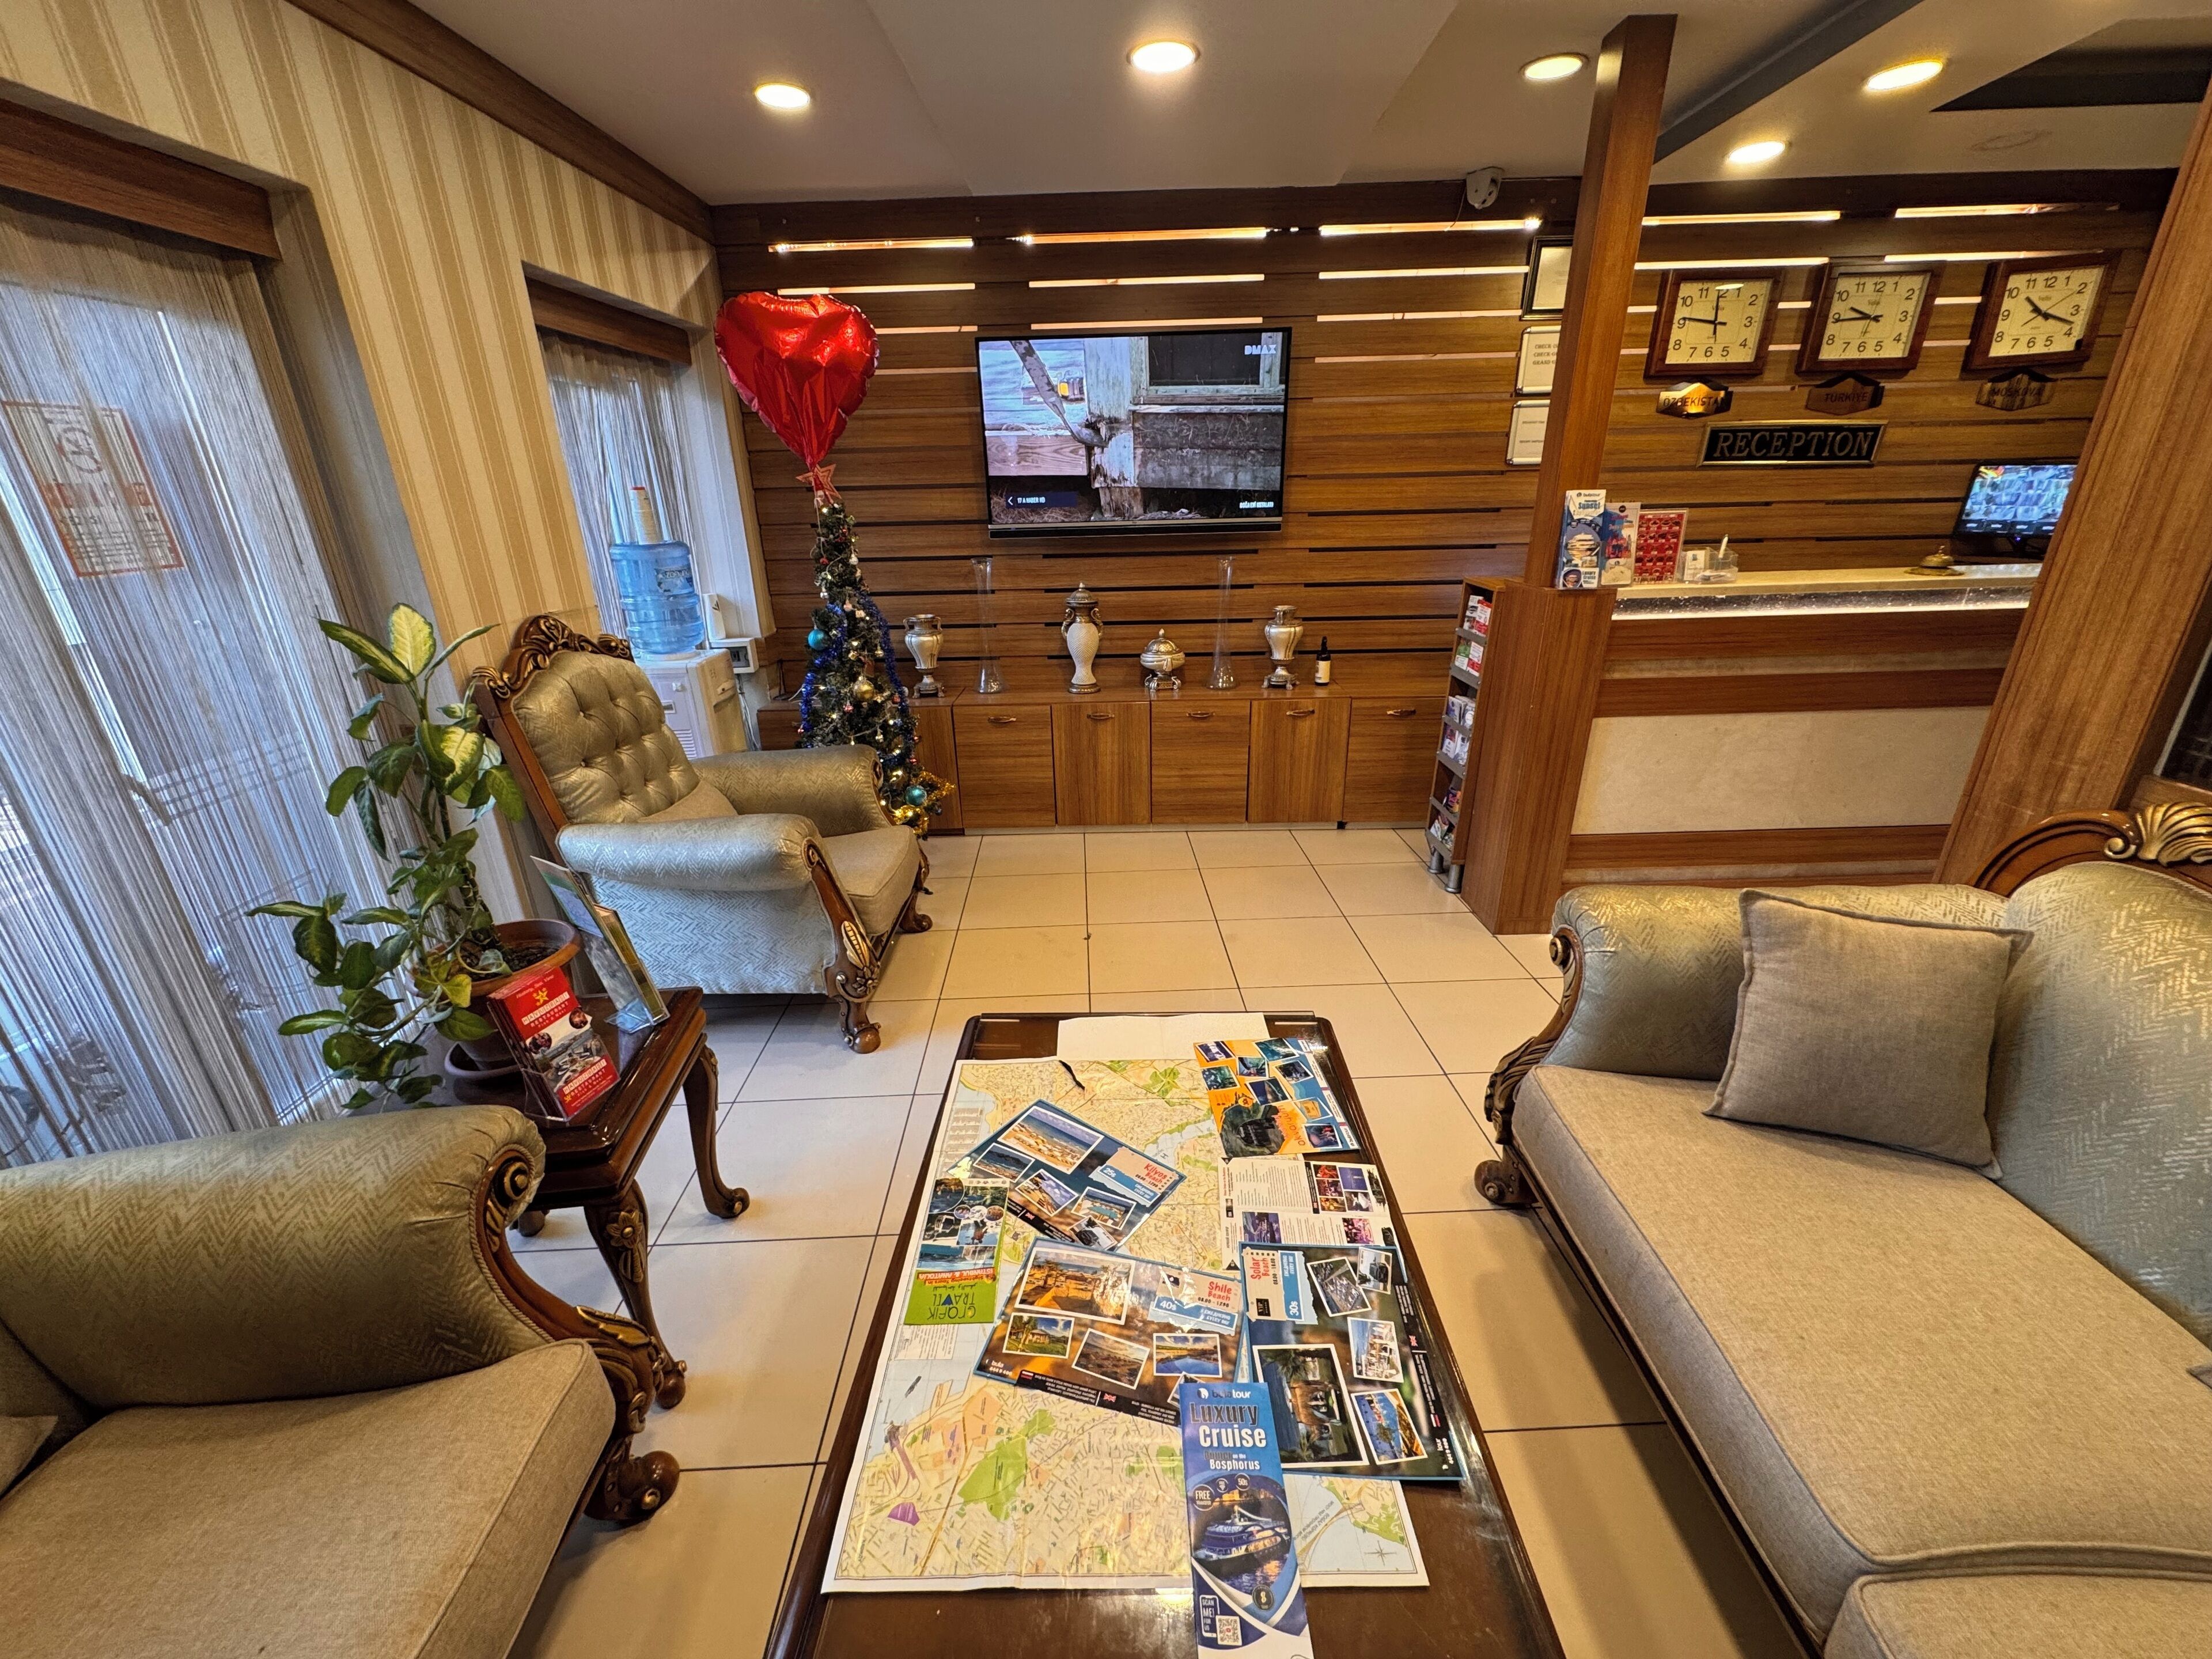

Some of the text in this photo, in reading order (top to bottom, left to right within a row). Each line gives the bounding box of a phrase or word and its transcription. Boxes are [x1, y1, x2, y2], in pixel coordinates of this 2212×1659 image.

[1873, 281, 1887, 293] 12
[1893, 281, 1899, 292] 1
[2026, 278, 2037, 289] 11
[2043, 276, 2058, 288] 12
[2065, 275, 2070, 287] 1
[1699, 287, 1709, 298] 11
[1855, 282, 1866, 293] 11
[2005, 287, 2020, 299] 10
[2076, 282, 2088, 294] 2
[1748, 294, 1758, 306] 2
[1836, 290, 1849, 302] 10
[1904, 289, 1915, 300] 2
[1680, 296, 1693, 307] 10
[1899, 310, 1908, 322] 3
[2001, 309, 2010, 321] 9
[2070, 304, 2080, 316] 3
[1677, 317, 1686, 329] 9
[1744, 316, 1753, 327] 3
[1832, 312, 1840, 324] 9
[1893, 332, 1902, 343] 4
[1994, 331, 2004, 343] 8
[2063, 327, 2073, 337] 4
[1673, 339, 1681, 351] 8
[1739, 338, 1748, 349] 4
[1826, 334, 1835, 346] 8
[1874, 340, 1884, 352] 5
[2011, 338, 2020, 350] 7
[2027, 337, 2036, 348] 6
[2044, 335, 2054, 347] 5
[1245, 344, 1277, 355] DMAX
[1689, 347, 1698, 358] 7
[1704, 346, 1713, 357] 6
[1721, 346, 1729, 357] 5
[1842, 342, 1850, 353] 7
[1857, 341, 1866, 352] 6
[1713, 431, 1874, 457] RECEPTION
[1145, 1172, 1162, 1184] Beach
[1250, 1257, 1261, 1280] Solar
[1260, 1257, 1270, 1277] Beach
[1208, 1281, 1232, 1294] Shile
[933, 1293, 975, 1306] TRAVEL
[1207, 1291, 1230, 1301] Beach
[1190, 1402, 1258, 1427] Luxury
[1199, 1424, 1266, 1448] Cruise
[1210, 1459, 1260, 1471] Bosphorus
[1195, 1491, 1210, 1499] FREE
[1202, 1599, 1214, 1607] SCAN
[1203, 1608, 1214, 1618] ME!
